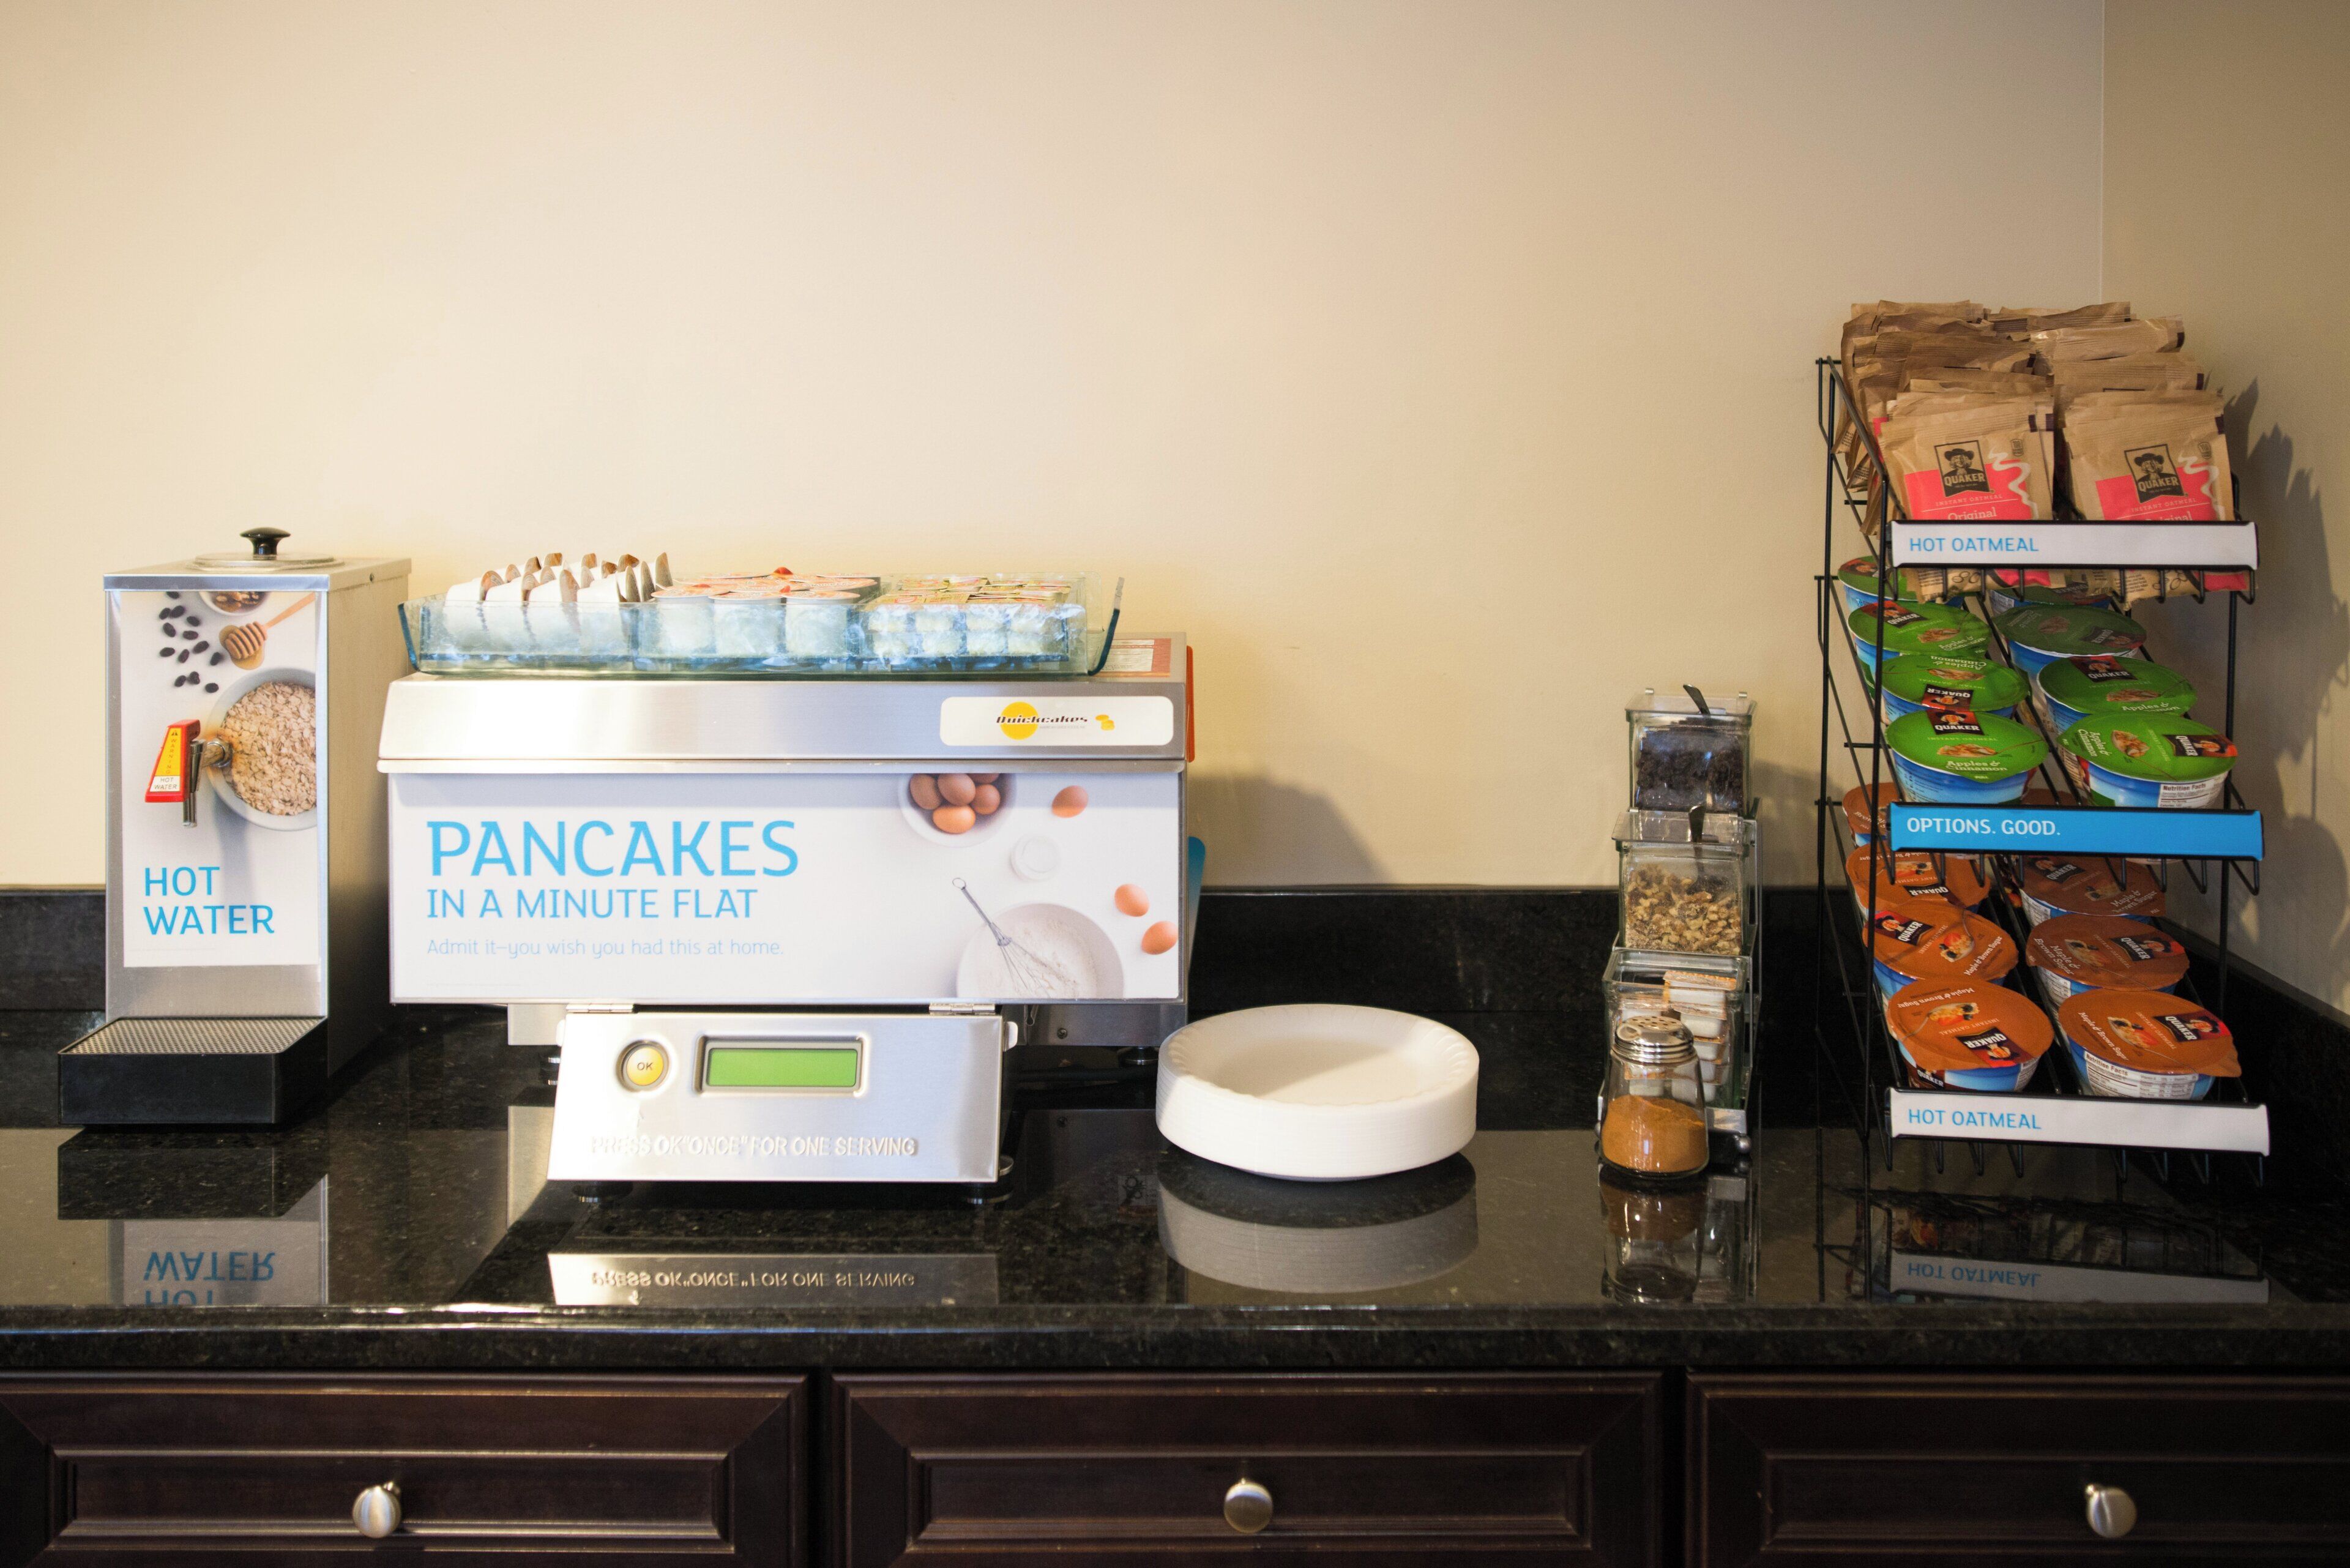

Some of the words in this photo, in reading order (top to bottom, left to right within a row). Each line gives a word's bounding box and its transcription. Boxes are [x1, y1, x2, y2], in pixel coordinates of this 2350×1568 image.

[1944, 472, 1986, 487] QUAKER
[2138, 476, 2180, 492] QUAKER
[1936, 498, 1968, 507] INSTANT
[1909, 538, 1945, 551] HOT
[1952, 538, 2039, 551] OATMEAL
[2088, 671, 2130, 679] QUAKER
[1927, 688, 1971, 698] QUAKER
[996, 715, 1088, 724] Quickcakes
[2175, 735, 2199, 756] QUAKER
[1906, 817, 1996, 834] OPTIONS.
[2001, 820, 2061, 836] GOOD.
[427, 820, 799, 878] PANCAKES
[145, 866, 220, 897] HOT
[2046, 864, 2078, 880] QUAKER
[1909, 886, 1949, 896] QUAKER
[2110, 893, 2136, 907] Maple
[2135, 890, 2158, 905] Sugar
[427, 889, 465, 919] IN
[479, 889, 503, 919] A
[517, 889, 659, 919] MINUTE
[674, 889, 758, 919] FLAT
[143, 905, 275, 935] WATER
[1898, 921, 1923, 942] QUAKER
[427, 939, 479, 955] Admit
[546, 939, 586, 955] wish
[592, 943, 625, 959] you
[631, 939, 663, 955] had
[670, 939, 701, 955] this
[707, 941, 724, 955] at
[729, 939, 784, 955] home.
[1964, 962, 1979, 976] Maple
[1977, 946, 1993, 961] Brown
[1988, 936, 2003, 949] Sugar
[2034, 938, 2056, 958] Brown
[2051, 945, 2072, 965] Maple
[2121, 937, 2151, 960] QUAKER
[1920, 993, 1945, 1004] Brown
[1951, 987, 1975, 997] Maple
[2078, 1012, 2095, 1028] Maple
[2097, 1030, 2115, 1047] Brown
[2164, 1015, 2198, 1040] QUAKER
[1963, 1032, 2007, 1048] QUAKER
[637, 1062, 653, 1071] OK
[2086, 1053, 2109, 1070] Nutrition
[2111, 1066, 2128, 1076] Facts
[1908, 1109, 1946, 1126] HOT
[1952, 1111, 2042, 1130] OATMEAL
[591, 1135, 651, 1156] PRESS
[750, 1137, 787, 1156] FOR
[794, 1137, 831, 1156] ONE
[835, 1137, 917, 1157] SERVING
